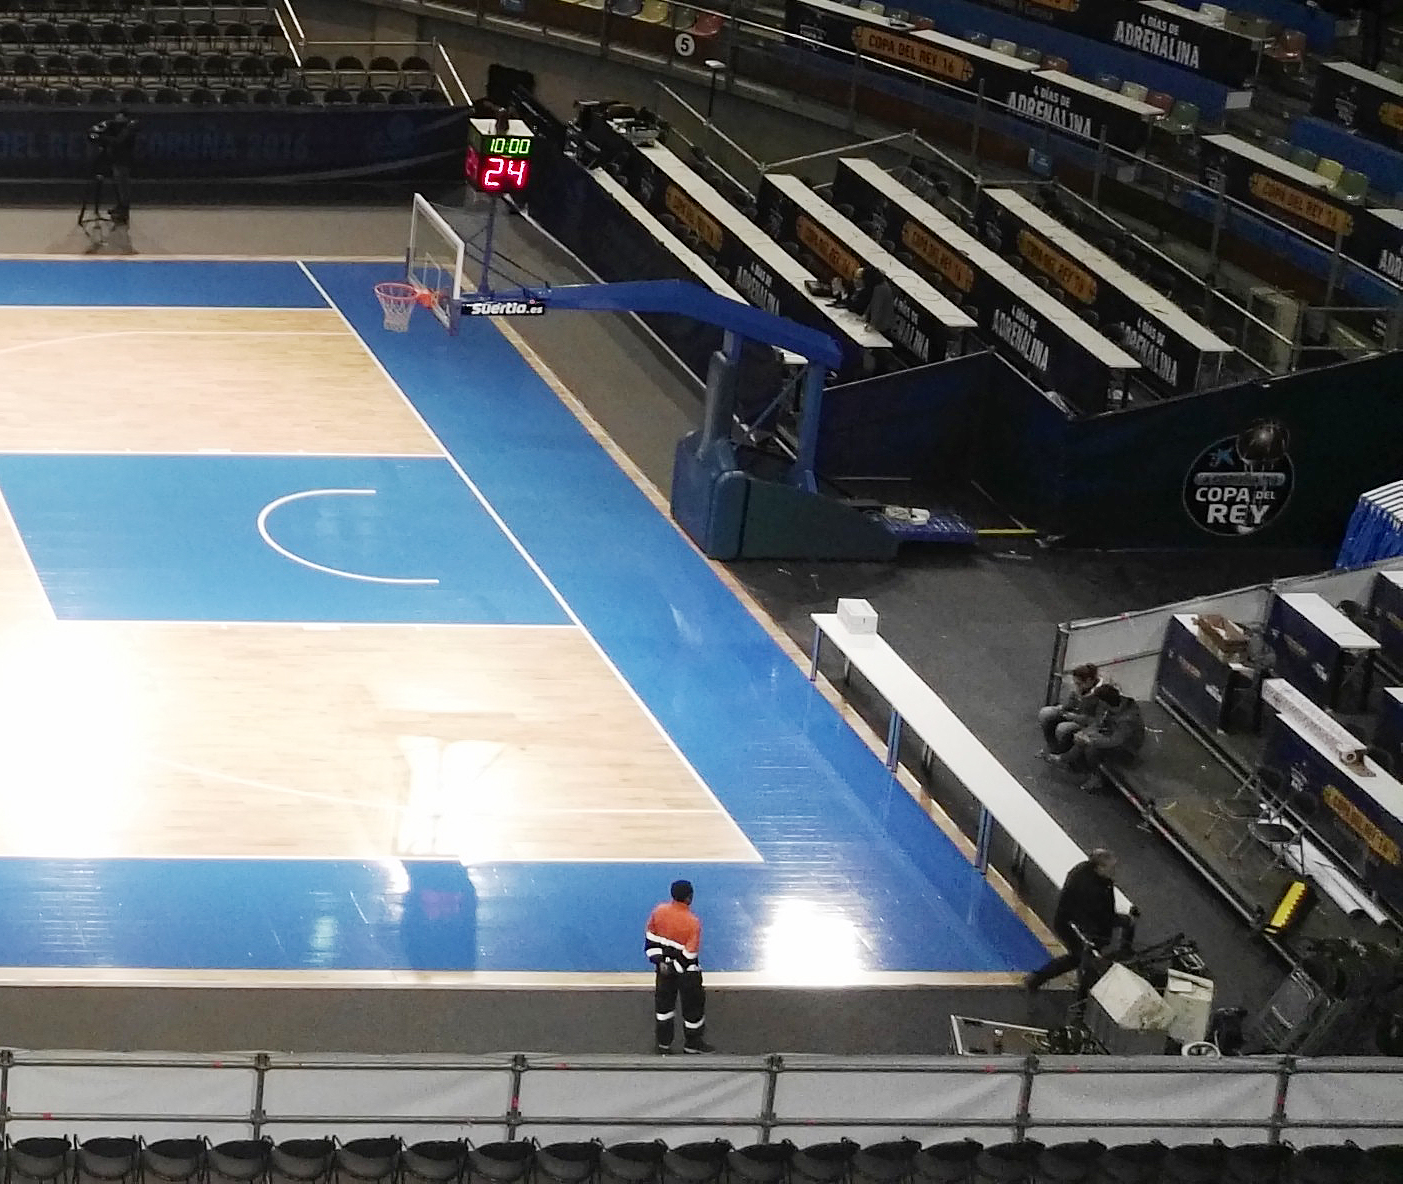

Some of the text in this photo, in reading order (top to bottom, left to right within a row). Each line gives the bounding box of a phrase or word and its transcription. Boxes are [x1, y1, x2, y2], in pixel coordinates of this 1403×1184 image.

[681, 37, 689, 52] 5
[868, 34, 895, 53] COPA
[898, 42, 917, 60] DEL
[919, 49, 938, 66] REY
[1113, 20, 1200, 69] ADRENALINA
[1007, 90, 1092, 138] ADRENALINA
[490, 138, 531, 154] 10:00
[484, 158, 526, 187] 24
[991, 308, 1050, 372] ADRENALINA
[1195, 487, 1276, 503] COPA DEL
[1206, 503, 1270, 524] REY
